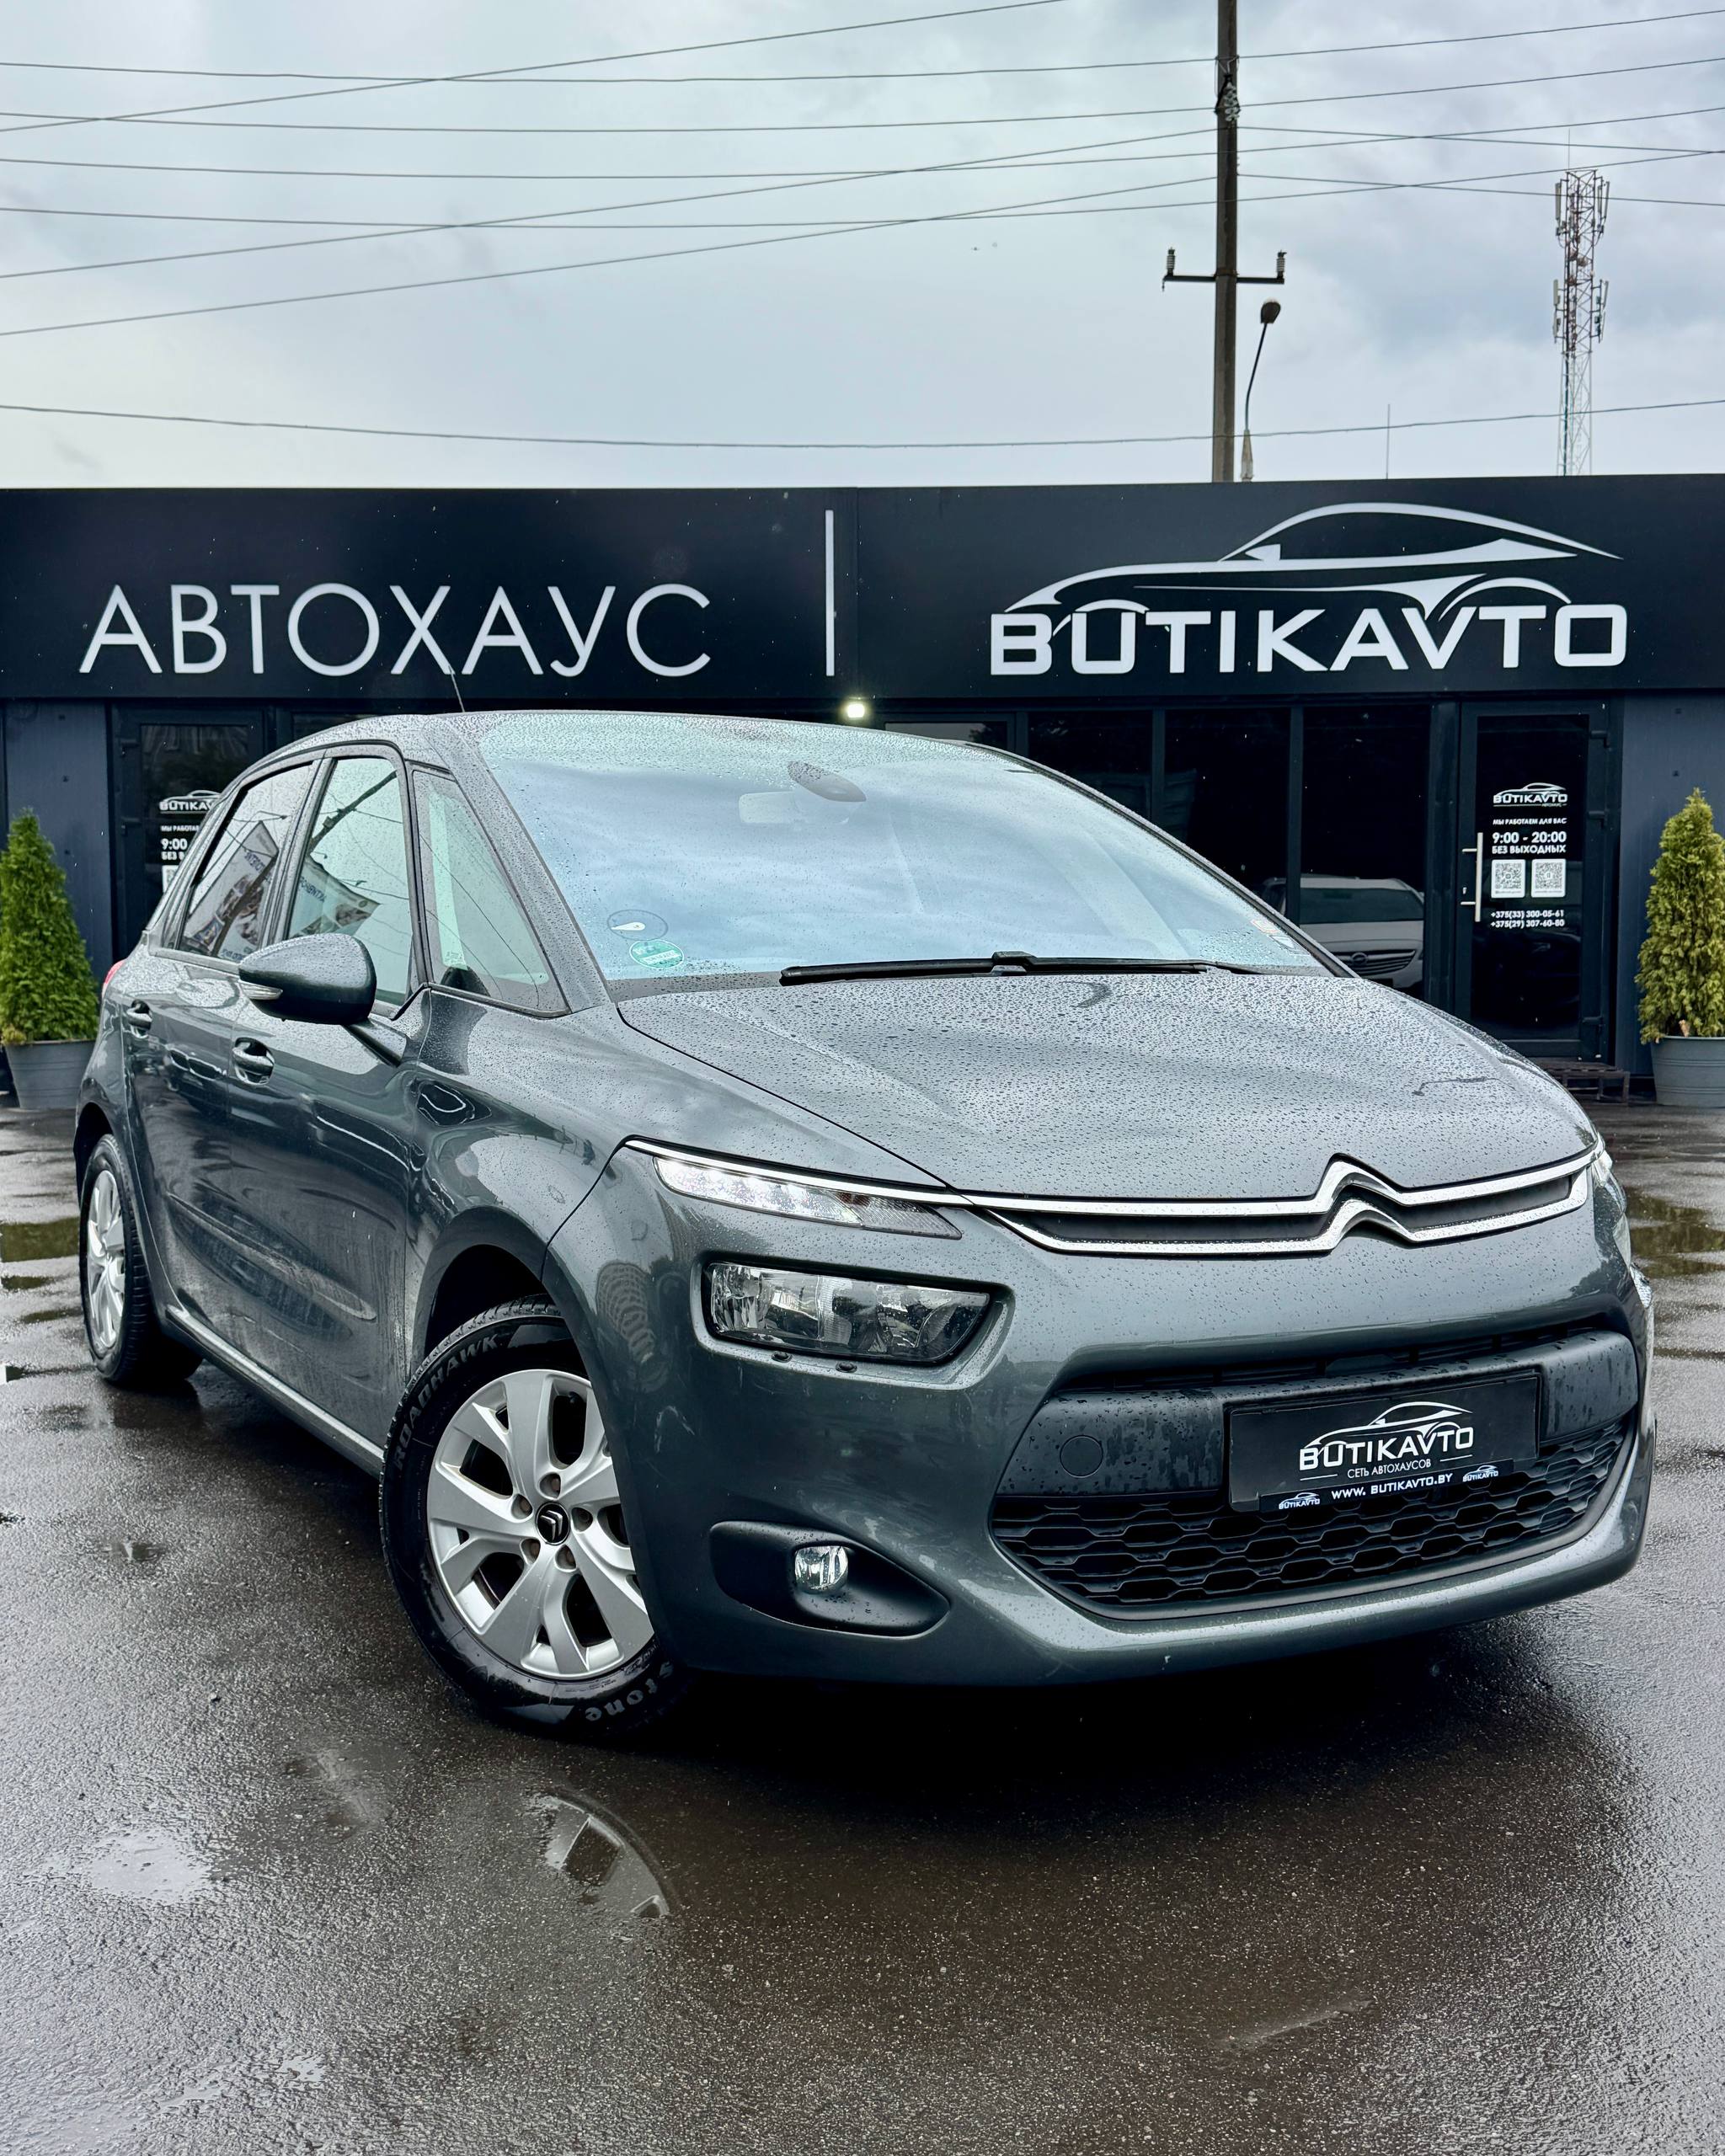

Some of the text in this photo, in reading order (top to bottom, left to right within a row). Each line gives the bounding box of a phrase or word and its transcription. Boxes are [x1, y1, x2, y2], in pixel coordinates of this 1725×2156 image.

[78, 581, 712, 677] АВТОХАУС
[990, 602, 1627, 675] BUTIKAVTO
[1493, 793, 1567, 803] BUTIKAVTO
[159, 800, 214, 810] BUTIKAV
[1492, 831, 1519, 844] 9:00
[1531, 830, 1567, 843] 20:00
[161, 838, 188, 850] 9:00
[1492, 845, 1566, 854] БЕЗ ВЫХОДНЫХ
[1300, 1426, 1473, 1471] BUTIKAVTO
[1347, 1458, 1432, 1479] СЕТЬ АВТОХАУСОВ
[1461, 1470, 1499, 1482] BUTIKAVTO
[1331, 1472, 1454, 1499] WWW. BUTIKAVTO.BY
[1278, 1498, 1321, 1510] BUTIKAVTO
